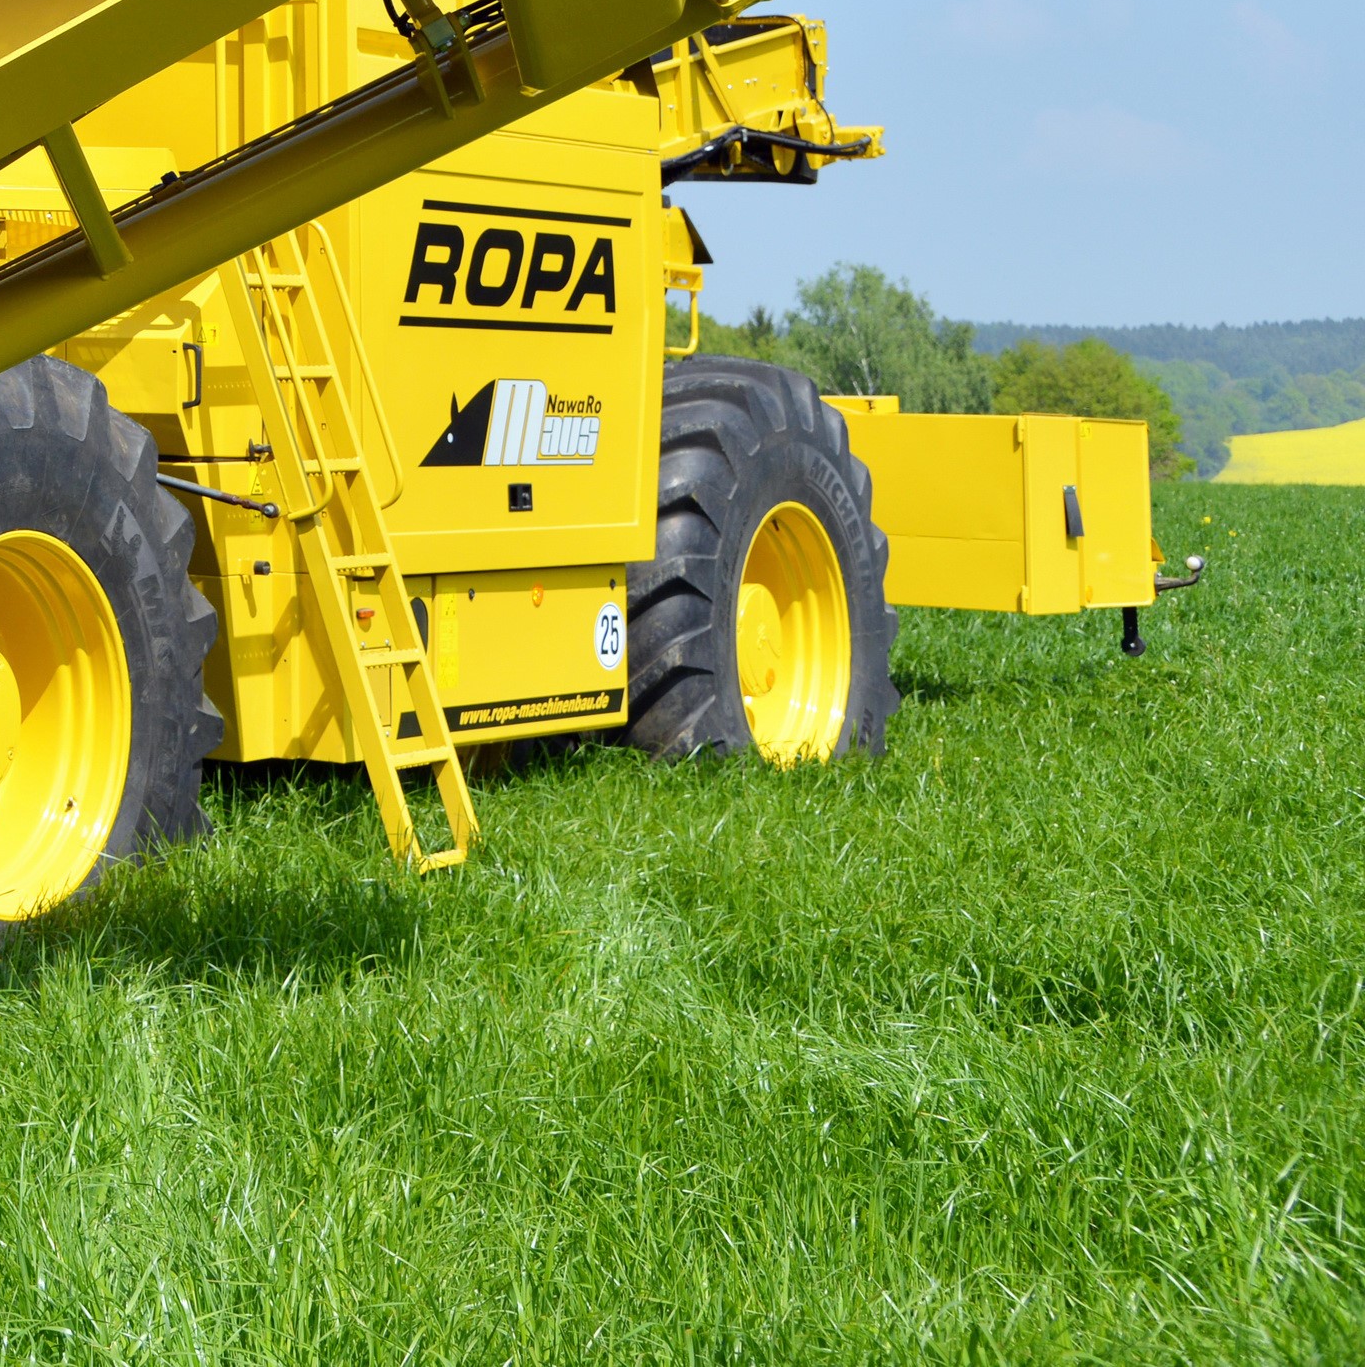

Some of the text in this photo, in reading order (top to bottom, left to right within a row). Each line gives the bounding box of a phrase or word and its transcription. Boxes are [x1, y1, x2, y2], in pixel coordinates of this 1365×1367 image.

[403, 221, 616, 313] ROPA
[546, 394, 602, 414] NawaRo
[809, 455, 873, 596] MICHELIN
[600, 614, 620, 655] 25
[459, 691, 610, 726] www.ropa-maschinenbau.de
